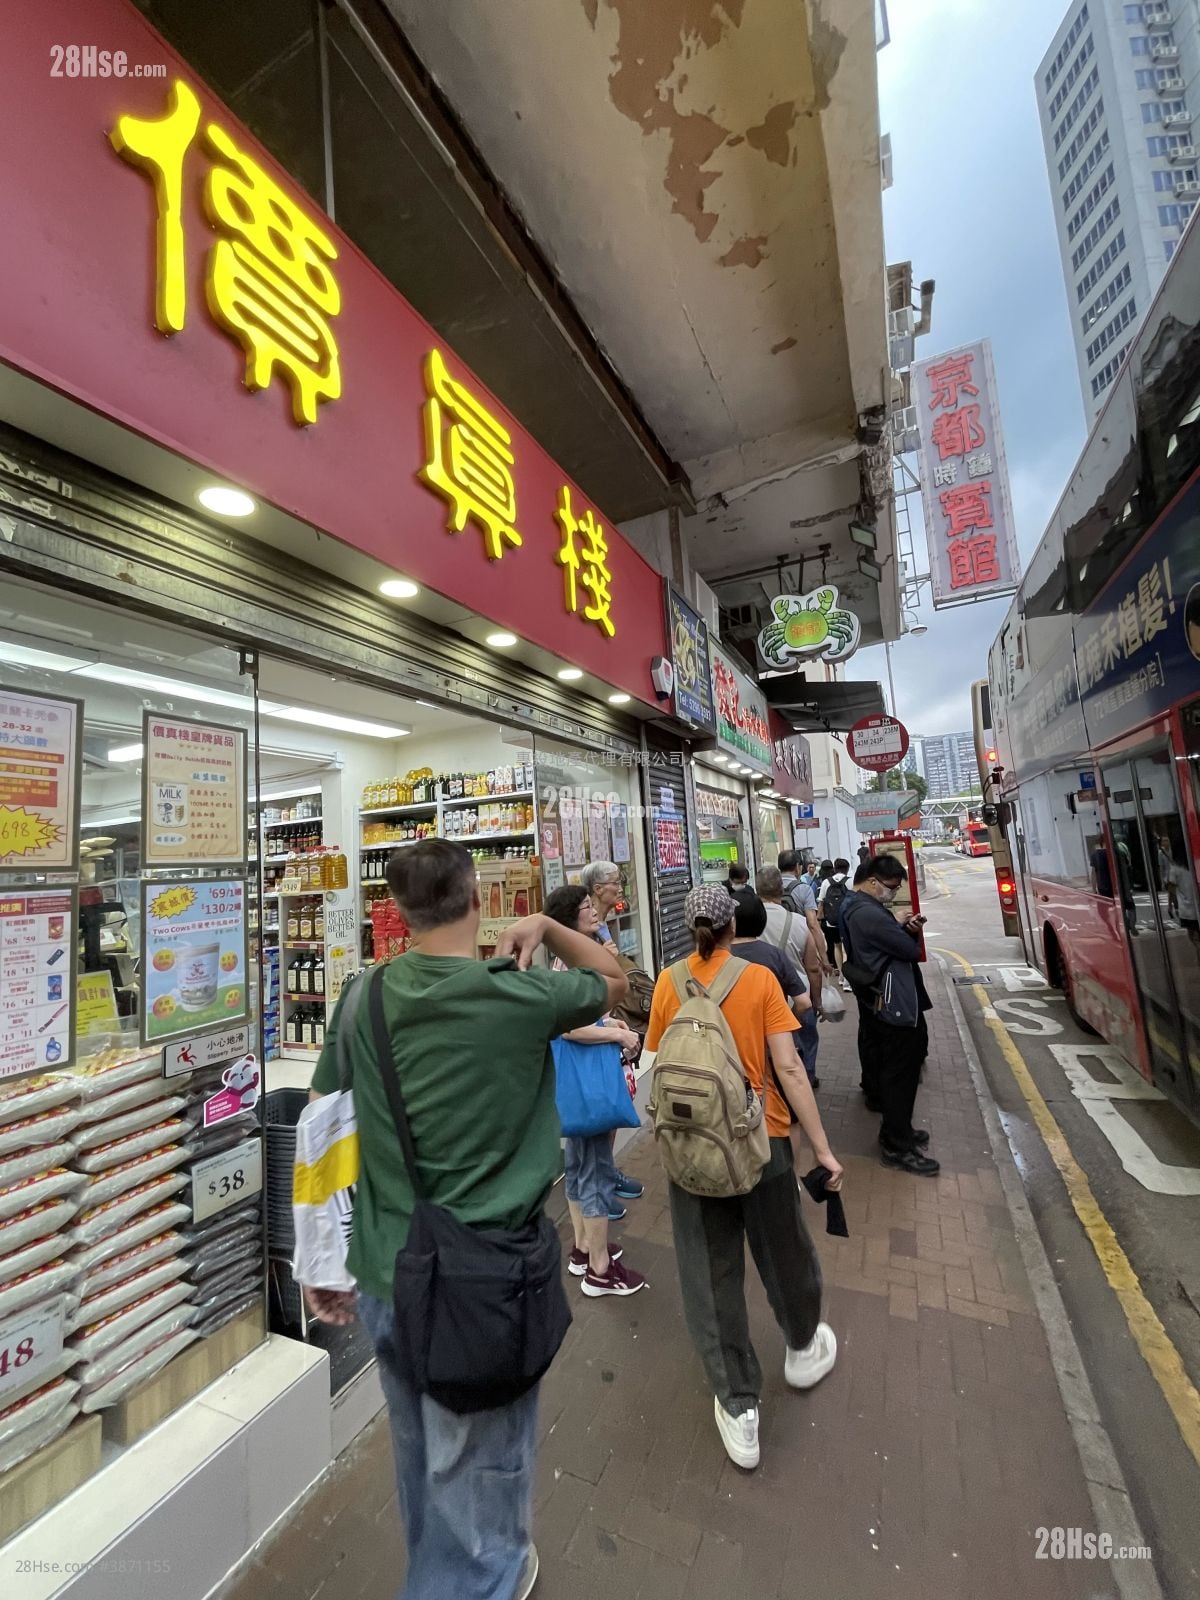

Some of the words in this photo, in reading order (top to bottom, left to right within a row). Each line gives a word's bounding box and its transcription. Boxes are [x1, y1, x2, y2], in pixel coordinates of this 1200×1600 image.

[926, 353, 986, 460] 京都
[939, 480, 1001, 590] 賓館
[1, 720, 33, 733] 28-32
[152, 724, 235, 748] 價真棧皇牌貨品
[159, 788, 182, 800] MILK
[800, 804, 810, 818] P
[328, 908, 354, 919] BETTER
[328, 916, 354, 926] OLIVES
[327, 922, 355, 934] BETTER
[206, 1032, 244, 1051] 小心地滑
[207, 1050, 229, 1060] Slippery
[208, 1169, 245, 1198] $38
